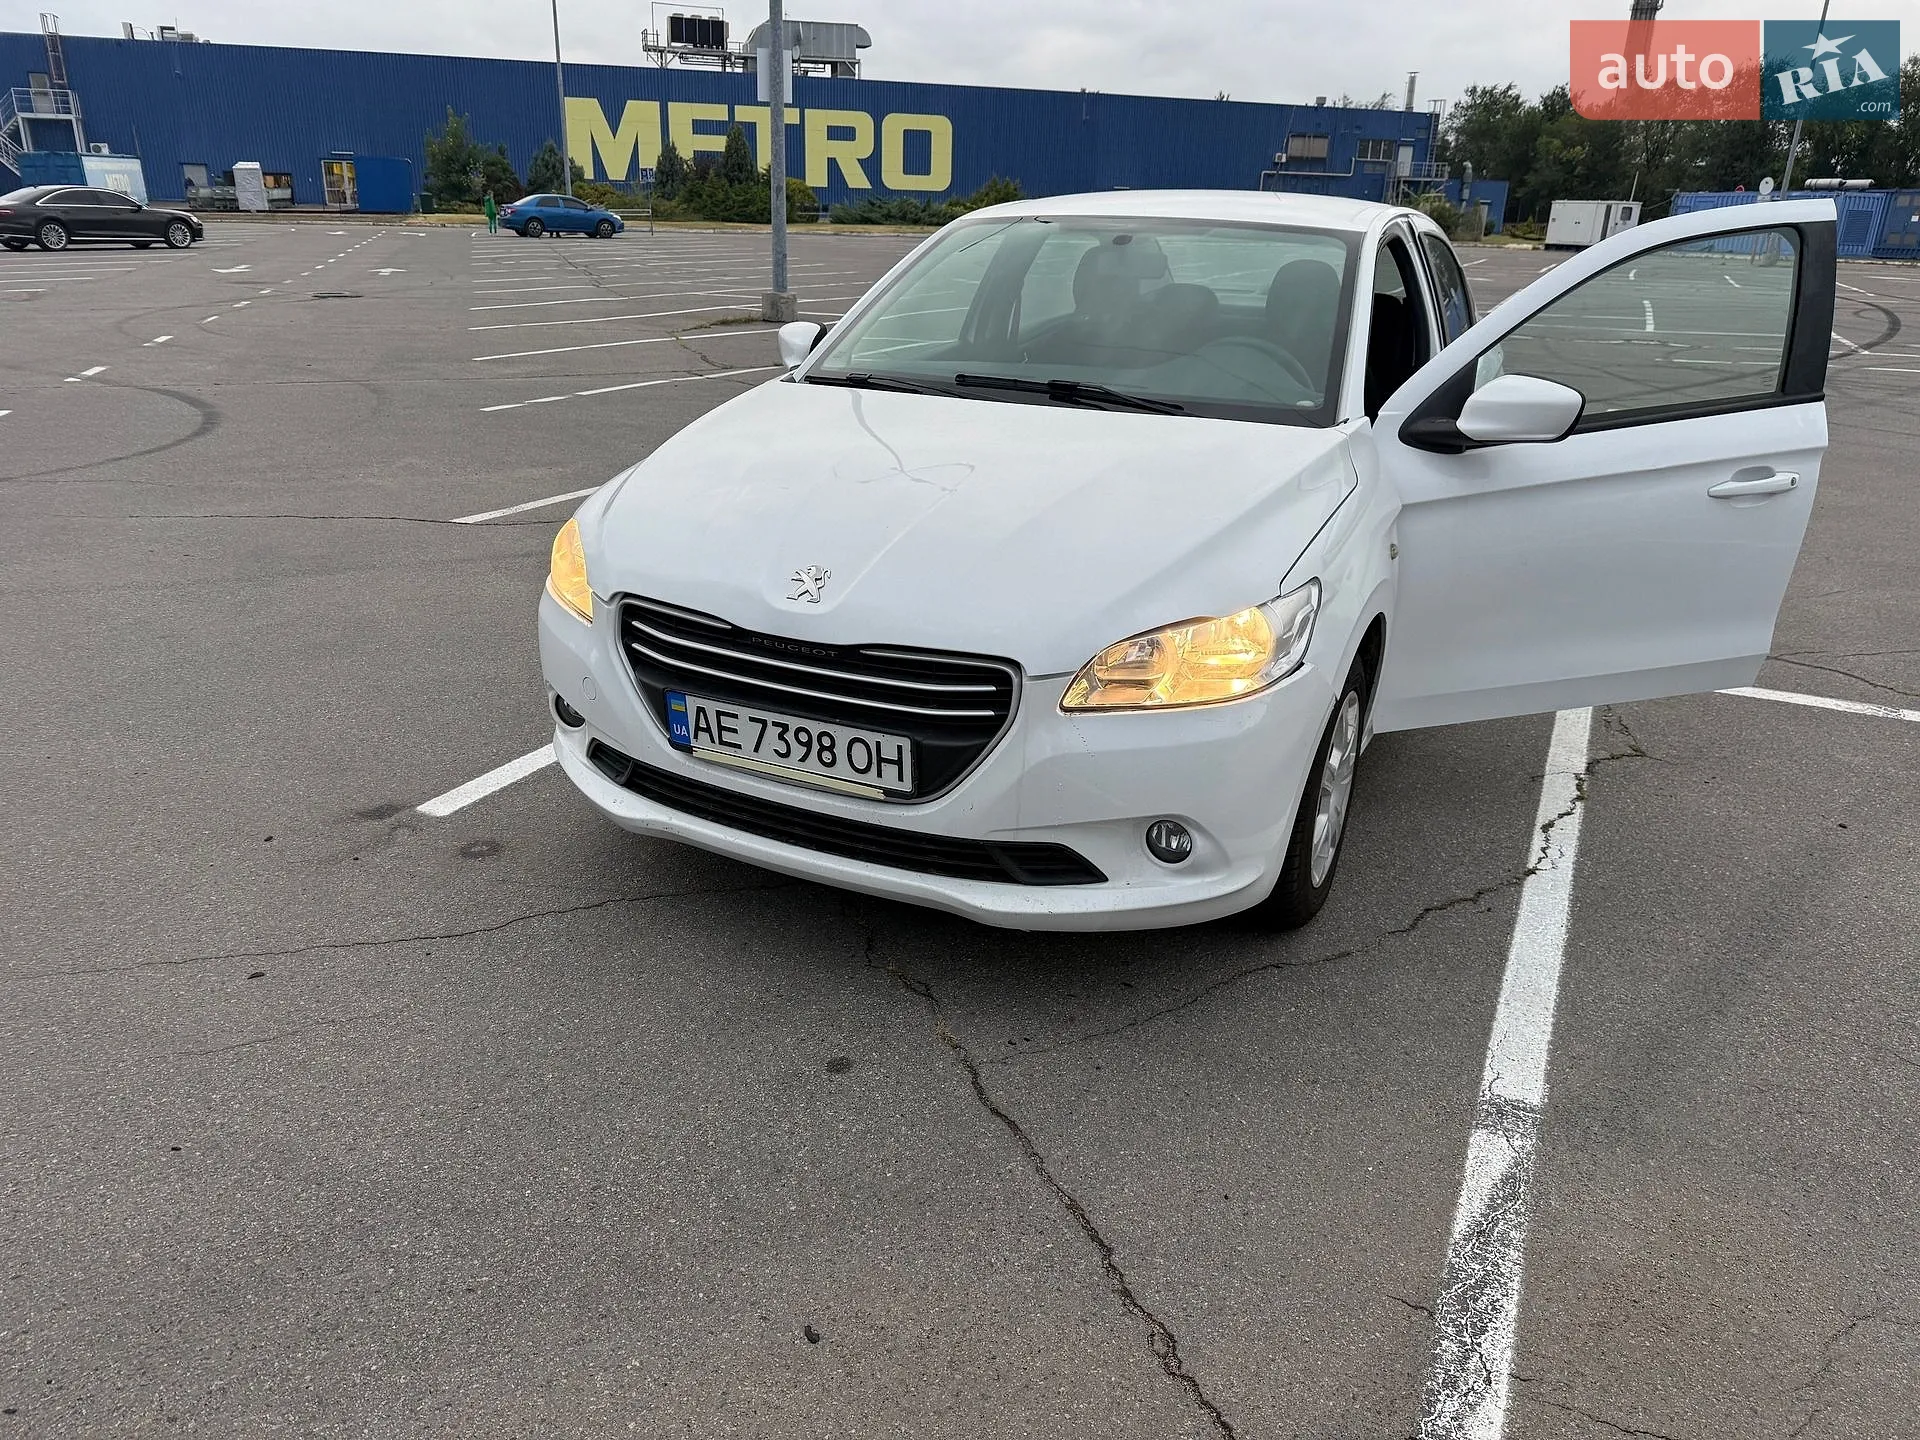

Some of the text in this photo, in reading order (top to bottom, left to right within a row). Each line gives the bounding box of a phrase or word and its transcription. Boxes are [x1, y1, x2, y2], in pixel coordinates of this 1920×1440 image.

[564, 97, 953, 191] METRO
[752, 637, 838, 656] PEUGEOT
[673, 723, 689, 737] UA
[693, 705, 743, 750] AE
[748, 715, 837, 768] 7398
